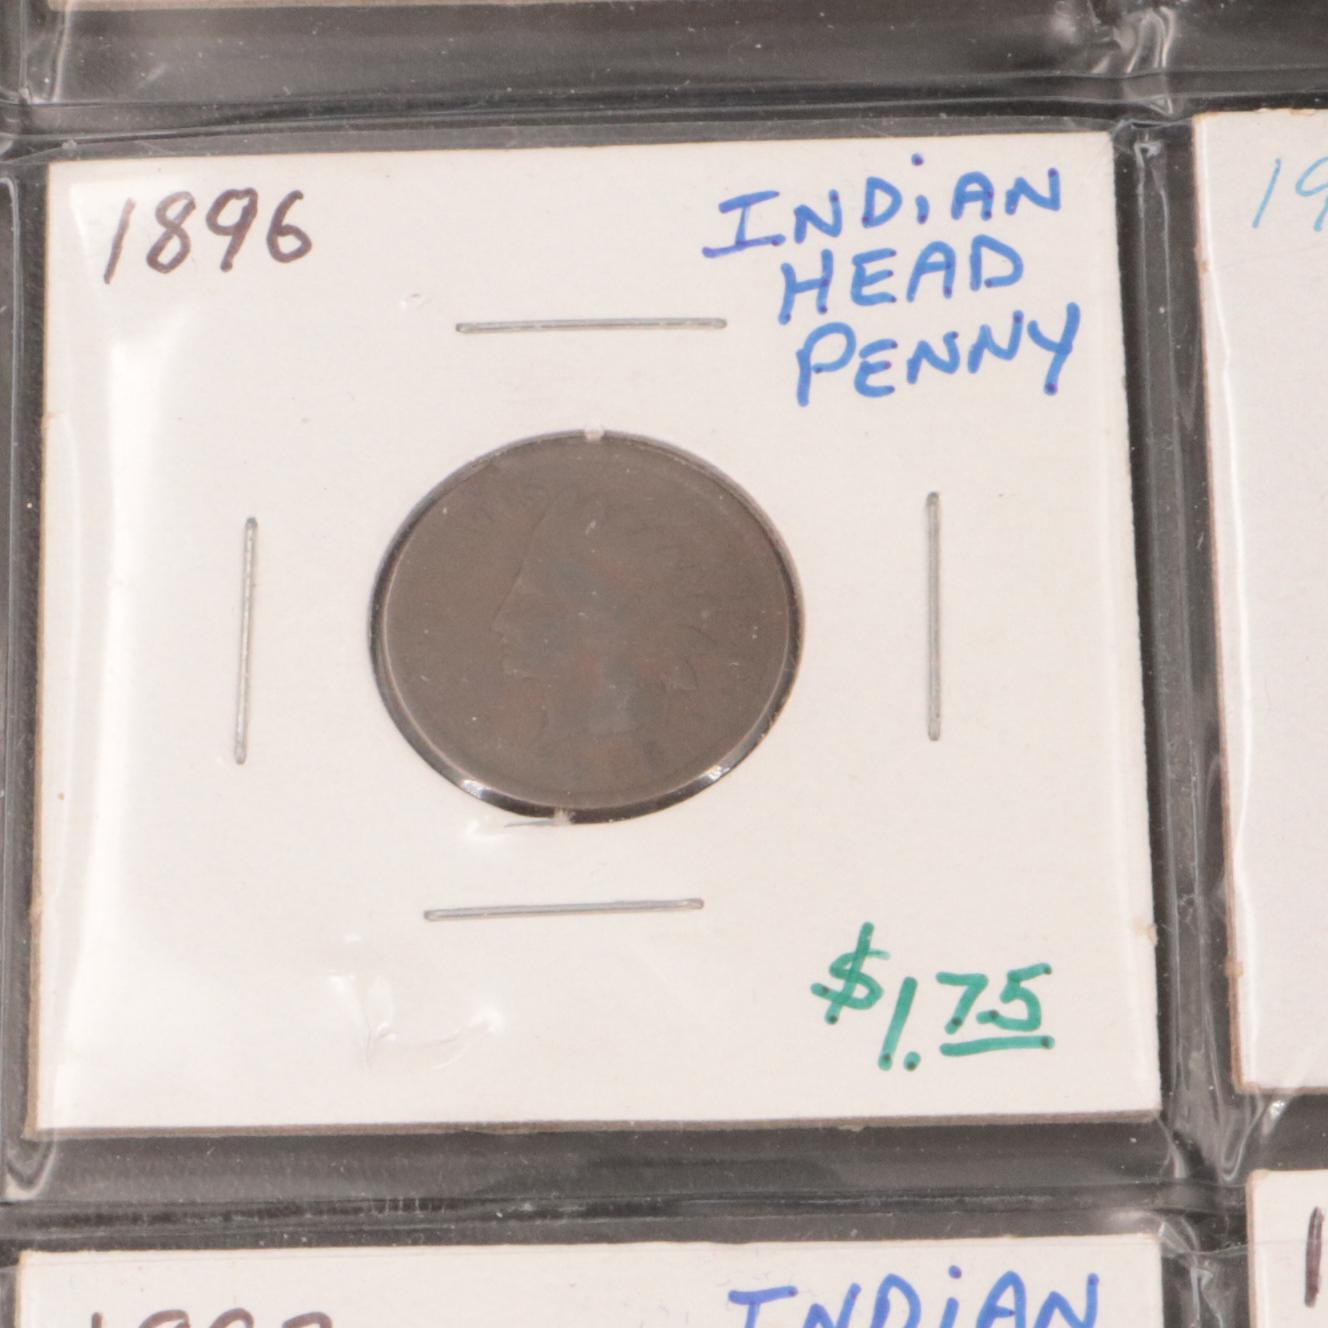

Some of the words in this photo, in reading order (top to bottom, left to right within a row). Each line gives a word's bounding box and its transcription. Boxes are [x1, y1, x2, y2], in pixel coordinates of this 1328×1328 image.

[104, 188, 312, 285] 1896
[778, 235, 1024, 327] HEAD
[796, 302, 1081, 408] PENNY
